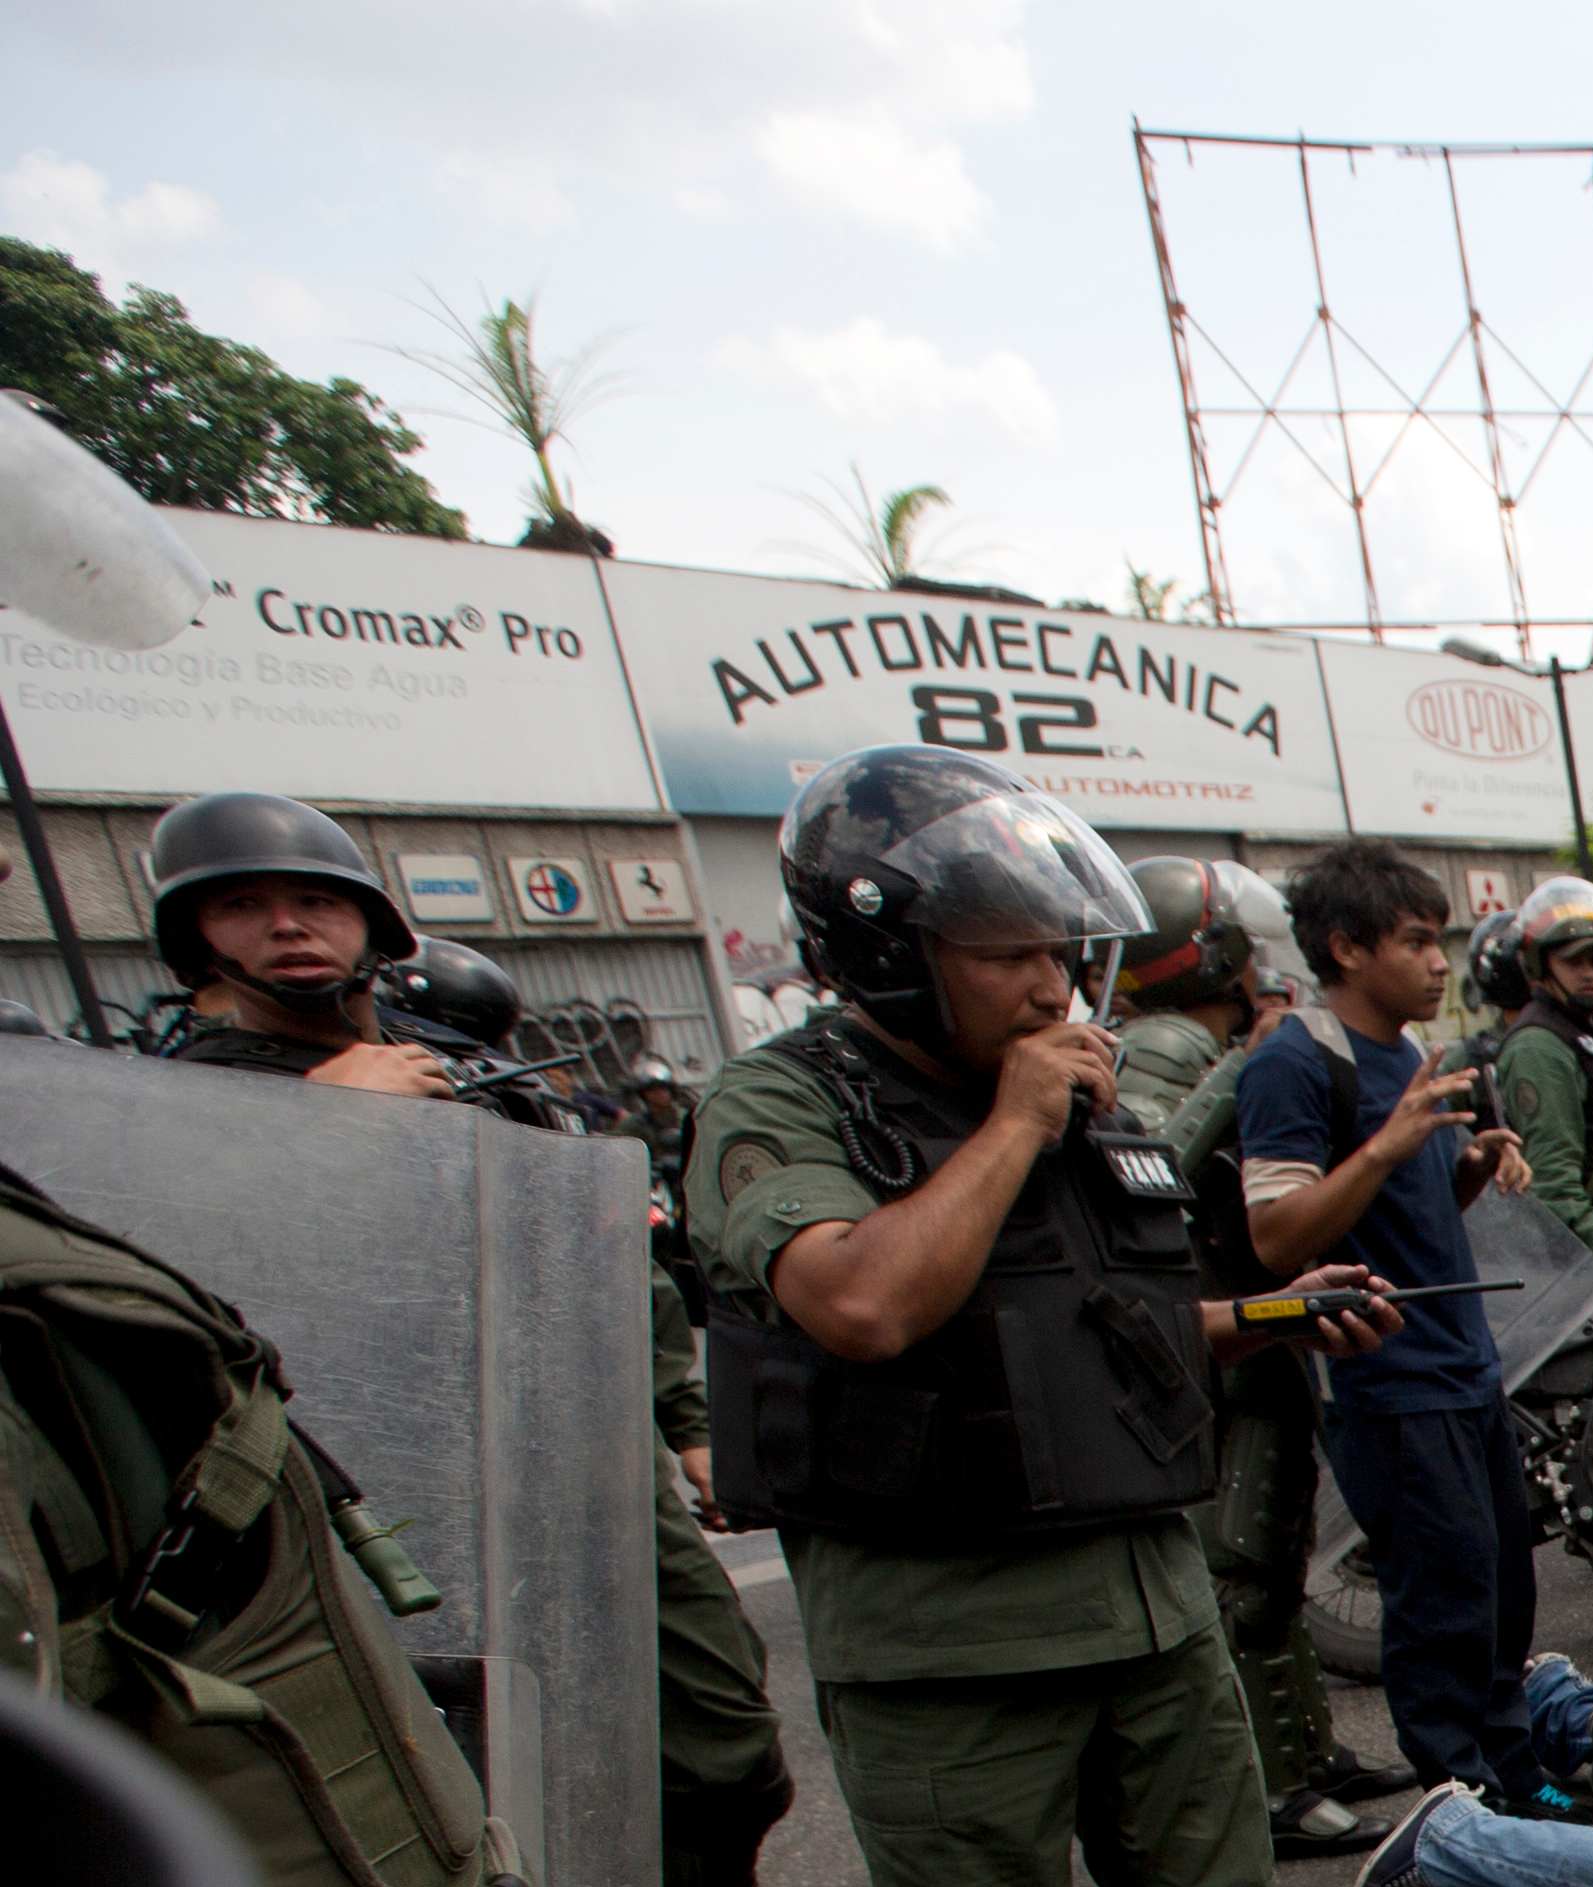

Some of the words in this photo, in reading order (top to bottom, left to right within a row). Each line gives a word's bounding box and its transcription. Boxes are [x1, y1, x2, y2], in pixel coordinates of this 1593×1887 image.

[256, 587, 486, 651] Cromax®
[500, 611, 584, 659] Pro
[255, 653, 353, 691] Base
[367, 664, 467, 701] Agua
[711, 612, 1281, 756] AUTOMECANICA
[911, 685, 1103, 758] 82
[1022, 775, 1254, 800] AUTOMOTRIZ
